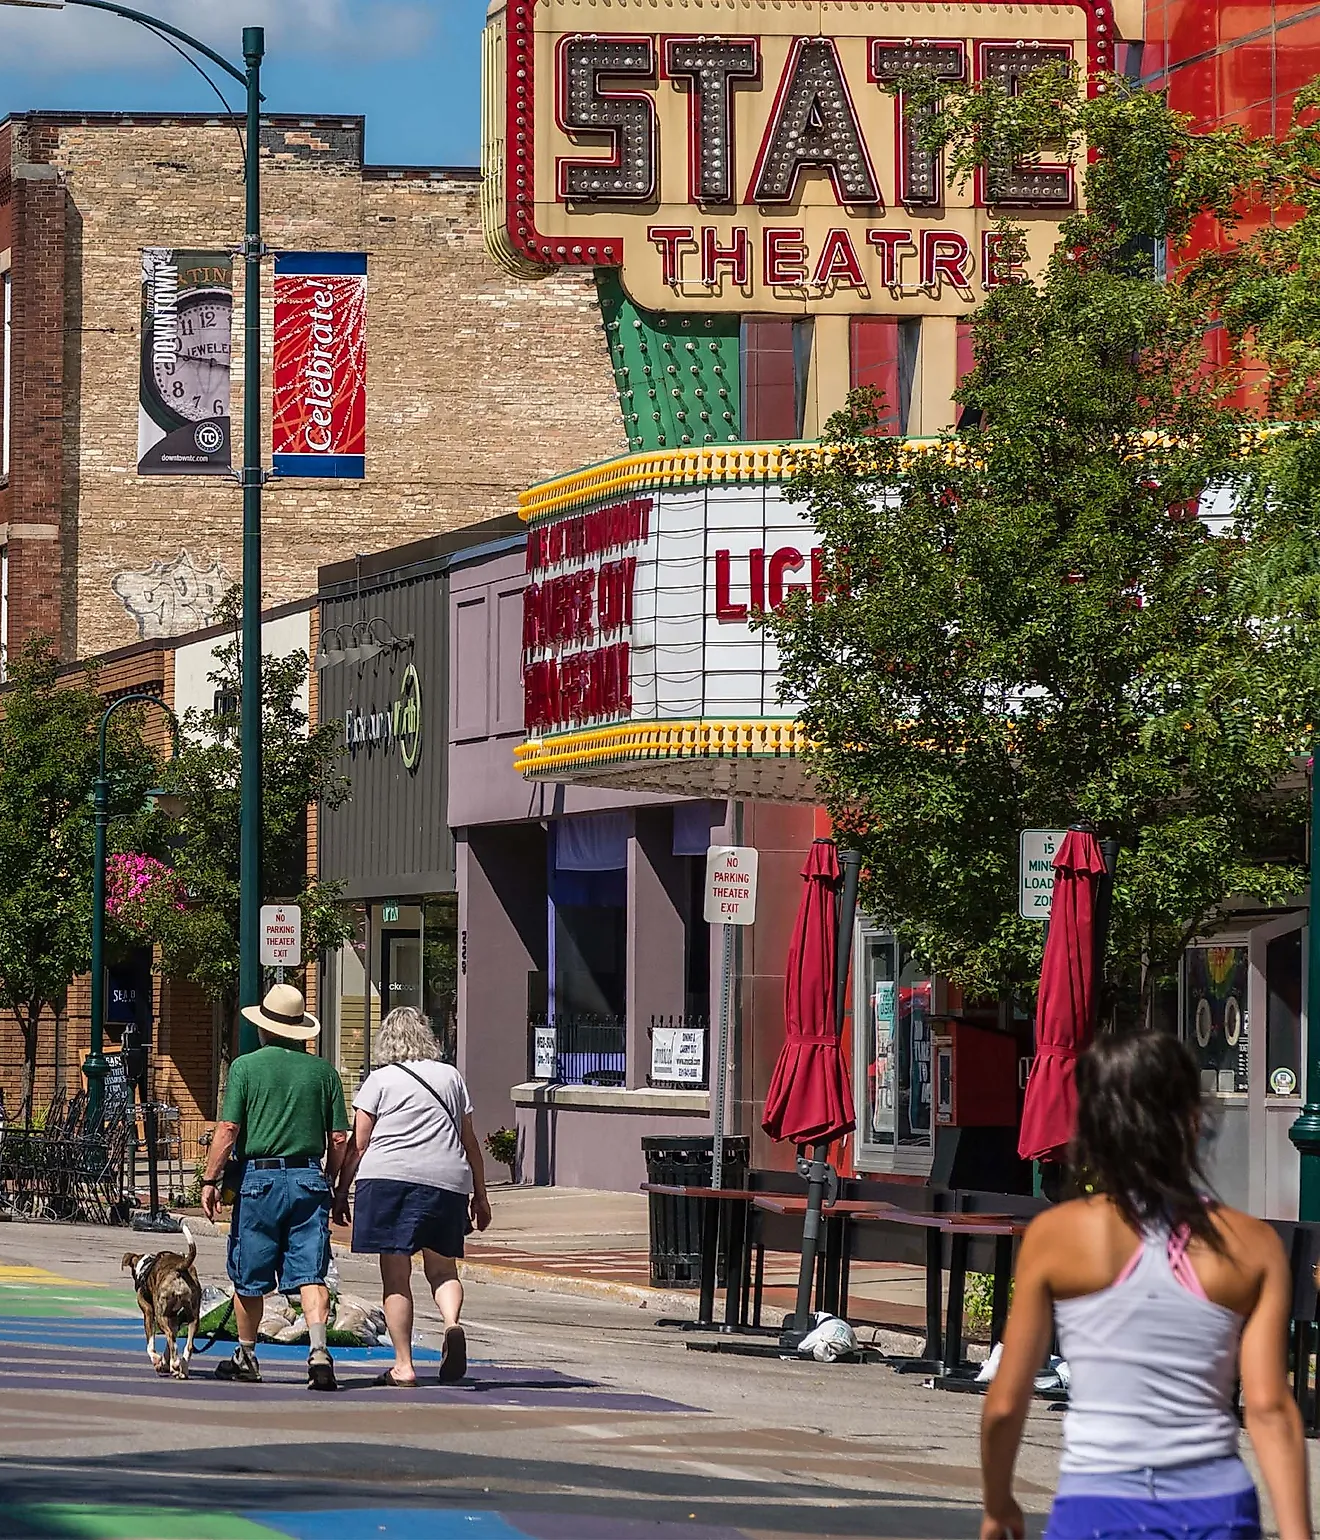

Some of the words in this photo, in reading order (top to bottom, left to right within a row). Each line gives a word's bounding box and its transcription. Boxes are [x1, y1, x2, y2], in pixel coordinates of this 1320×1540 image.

[554, 34, 1076, 208] STATE
[647, 226, 1027, 290] THEATRE
[153, 265, 178, 363] DOWNTOWN
[187, 342, 231, 358] JEWELE
[304, 280, 334, 451] Celebrate!
[202, 432, 215, 443] TC
[161, 454, 209, 463] downtowntc.com
[1044, 843, 1055, 854] 15
[727, 858, 738, 867] NO
[1029, 860, 1056, 872] MINU
[714, 872, 750, 883] PARKING
[1024, 878, 1055, 889] LOAD
[713, 887, 749, 898] THEATER
[721, 903, 739, 913] EXIT
[275, 914, 285, 922] NO
[266, 926, 295, 934] PARKING
[266, 938, 295, 946] THEATER
[273, 949, 288, 957] EXIT
